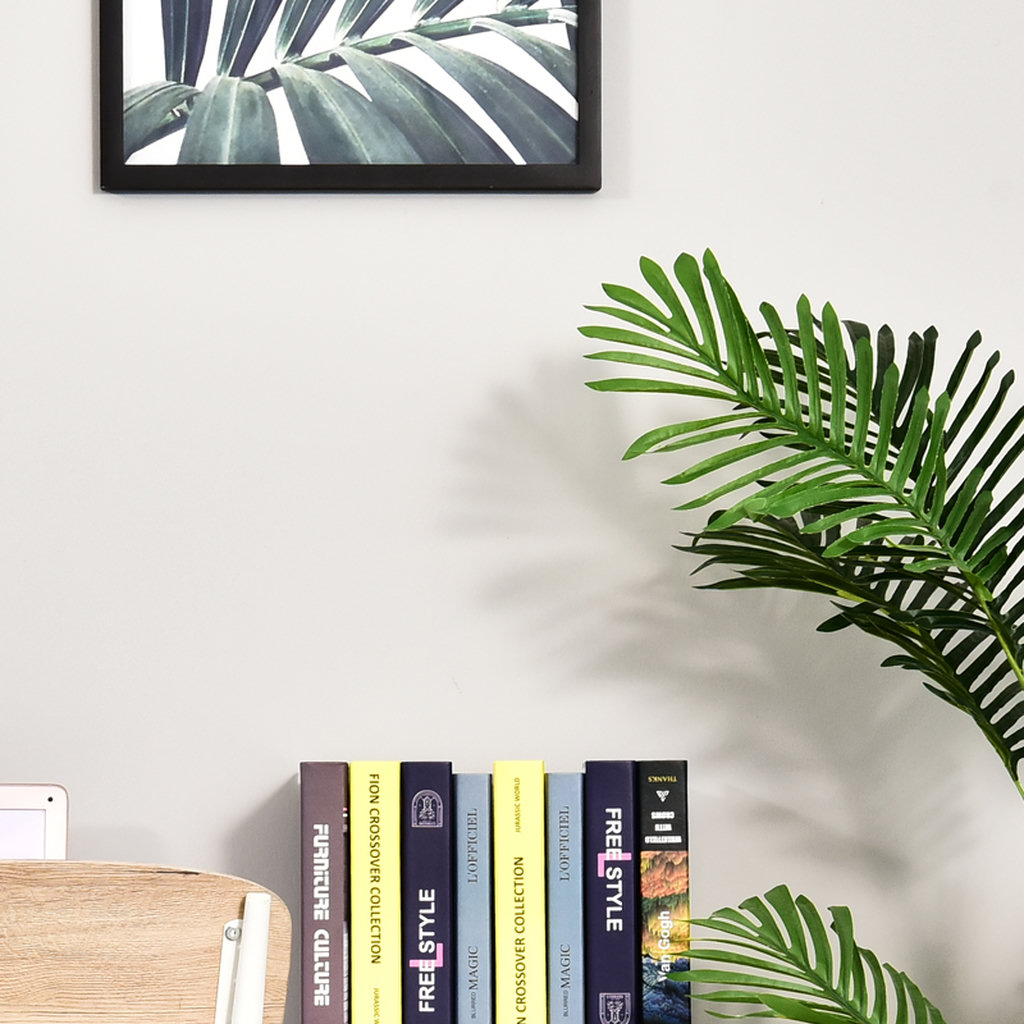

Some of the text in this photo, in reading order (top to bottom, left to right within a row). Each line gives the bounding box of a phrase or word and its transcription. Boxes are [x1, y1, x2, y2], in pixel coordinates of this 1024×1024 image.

[648, 775, 678, 783] THANKS
[368, 773, 382, 964] FION CROSSOVER COLLECTION
[466, 808, 478, 883] L'OFFICIEL
[559, 806, 570, 881] L'OFFICIEL
[605, 808, 623, 932] FREE STYLE
[512, 856, 525, 934] COLLECTION
[313, 928, 330, 1007] CULTURE
[418, 888, 436, 1012] FREE STYLE
[467, 945, 479, 990] MAGIC
[514, 937, 527, 1013] CROSSOVER
[560, 944, 571, 989] MAGIC
[657, 910, 673, 983] Van Gogh
